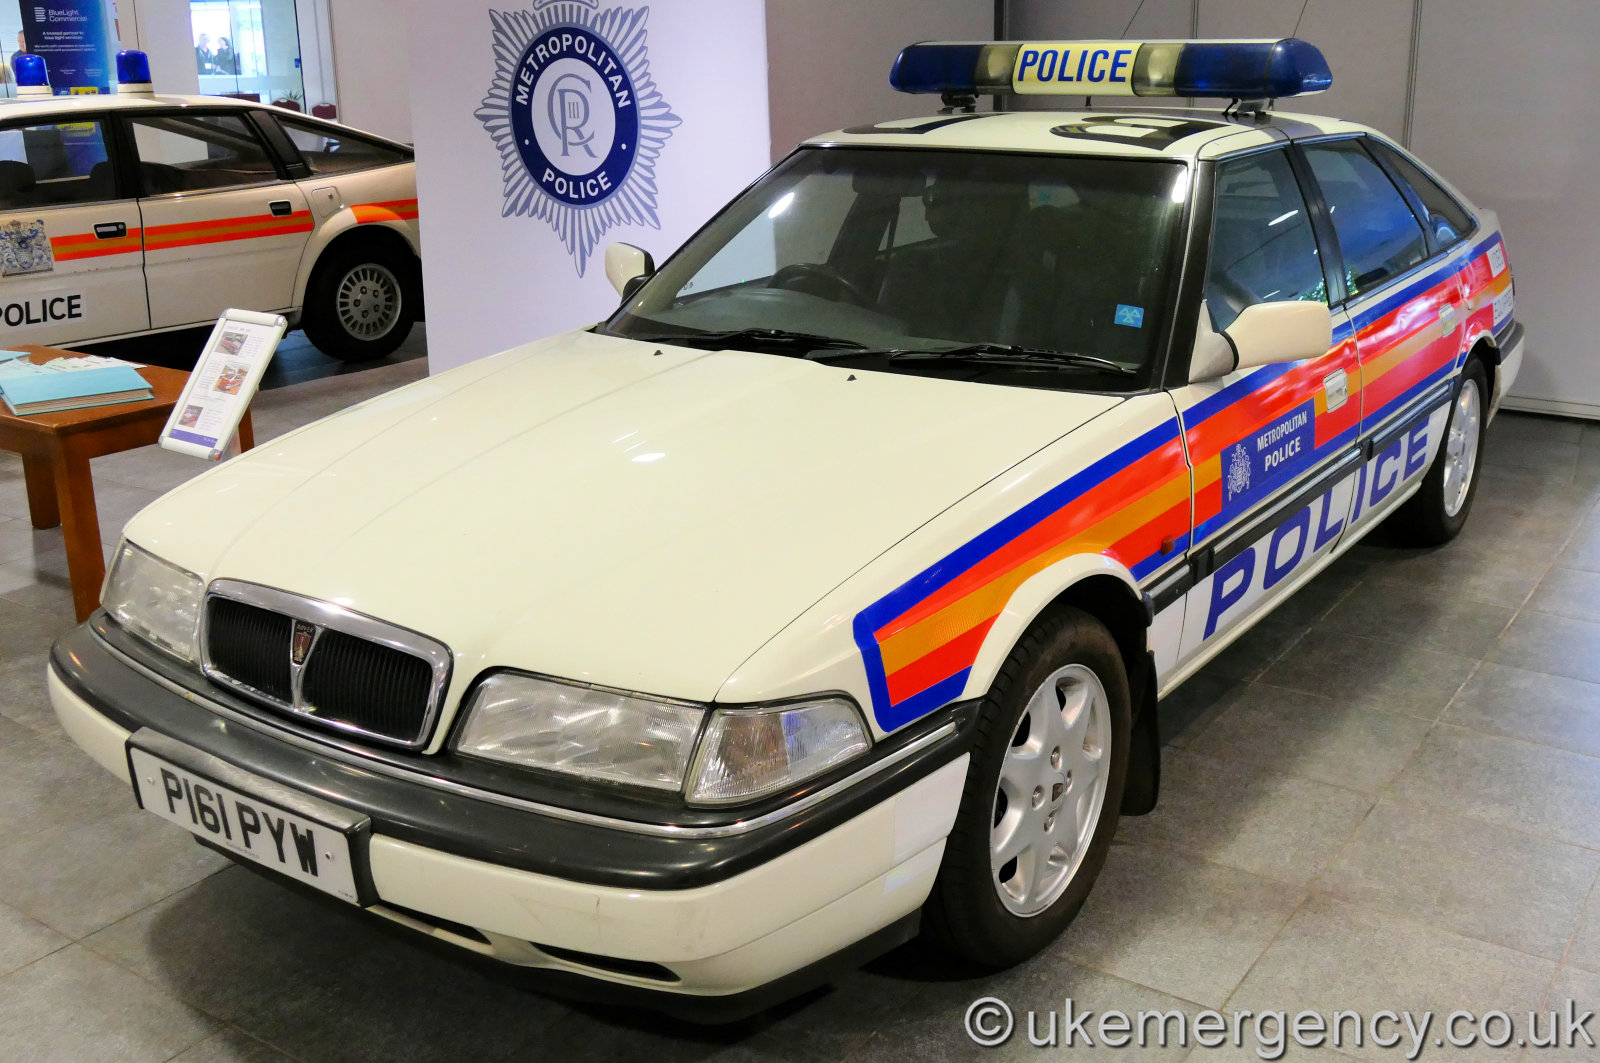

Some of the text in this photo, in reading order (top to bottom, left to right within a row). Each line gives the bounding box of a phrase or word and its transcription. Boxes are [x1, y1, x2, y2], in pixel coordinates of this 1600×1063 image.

[48, 9, 79, 17] BlueLight
[515, 33, 631, 109] METROPOLITAN
[1017, 48, 1133, 83] POLICE
[542, 167, 612, 199] POLICE
[0, 294, 82, 327] OLICE
[1256, 411, 1307, 452] METROPOLITAN
[1264, 437, 1301, 471] POLICE
[1203, 413, 1430, 641] POLICE
[160, 768, 318, 877] P161 PYW
